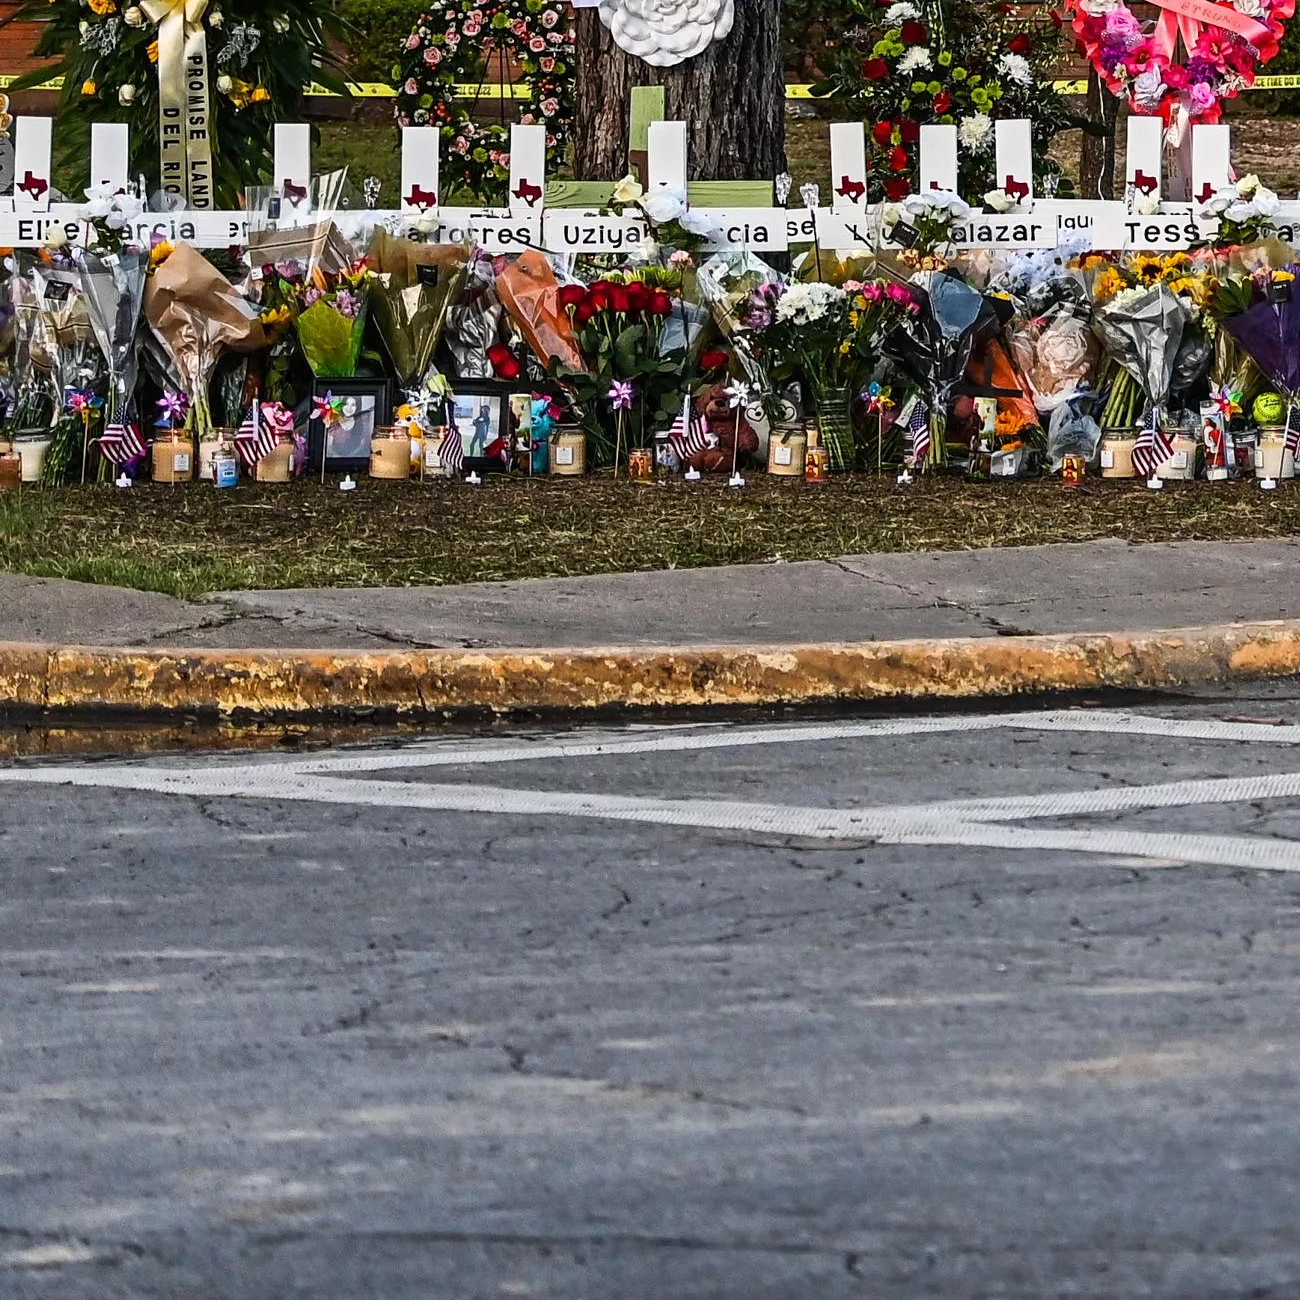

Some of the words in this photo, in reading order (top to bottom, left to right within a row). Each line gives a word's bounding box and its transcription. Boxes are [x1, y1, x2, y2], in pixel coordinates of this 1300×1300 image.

[187, 55, 206, 140] PROMISE
[163, 108, 181, 150] DEL
[191, 160, 210, 210] LAND
[119, 220, 196, 240] arcia
[950, 223, 1043, 243] alazar
[1124, 222, 1201, 243] Tess
